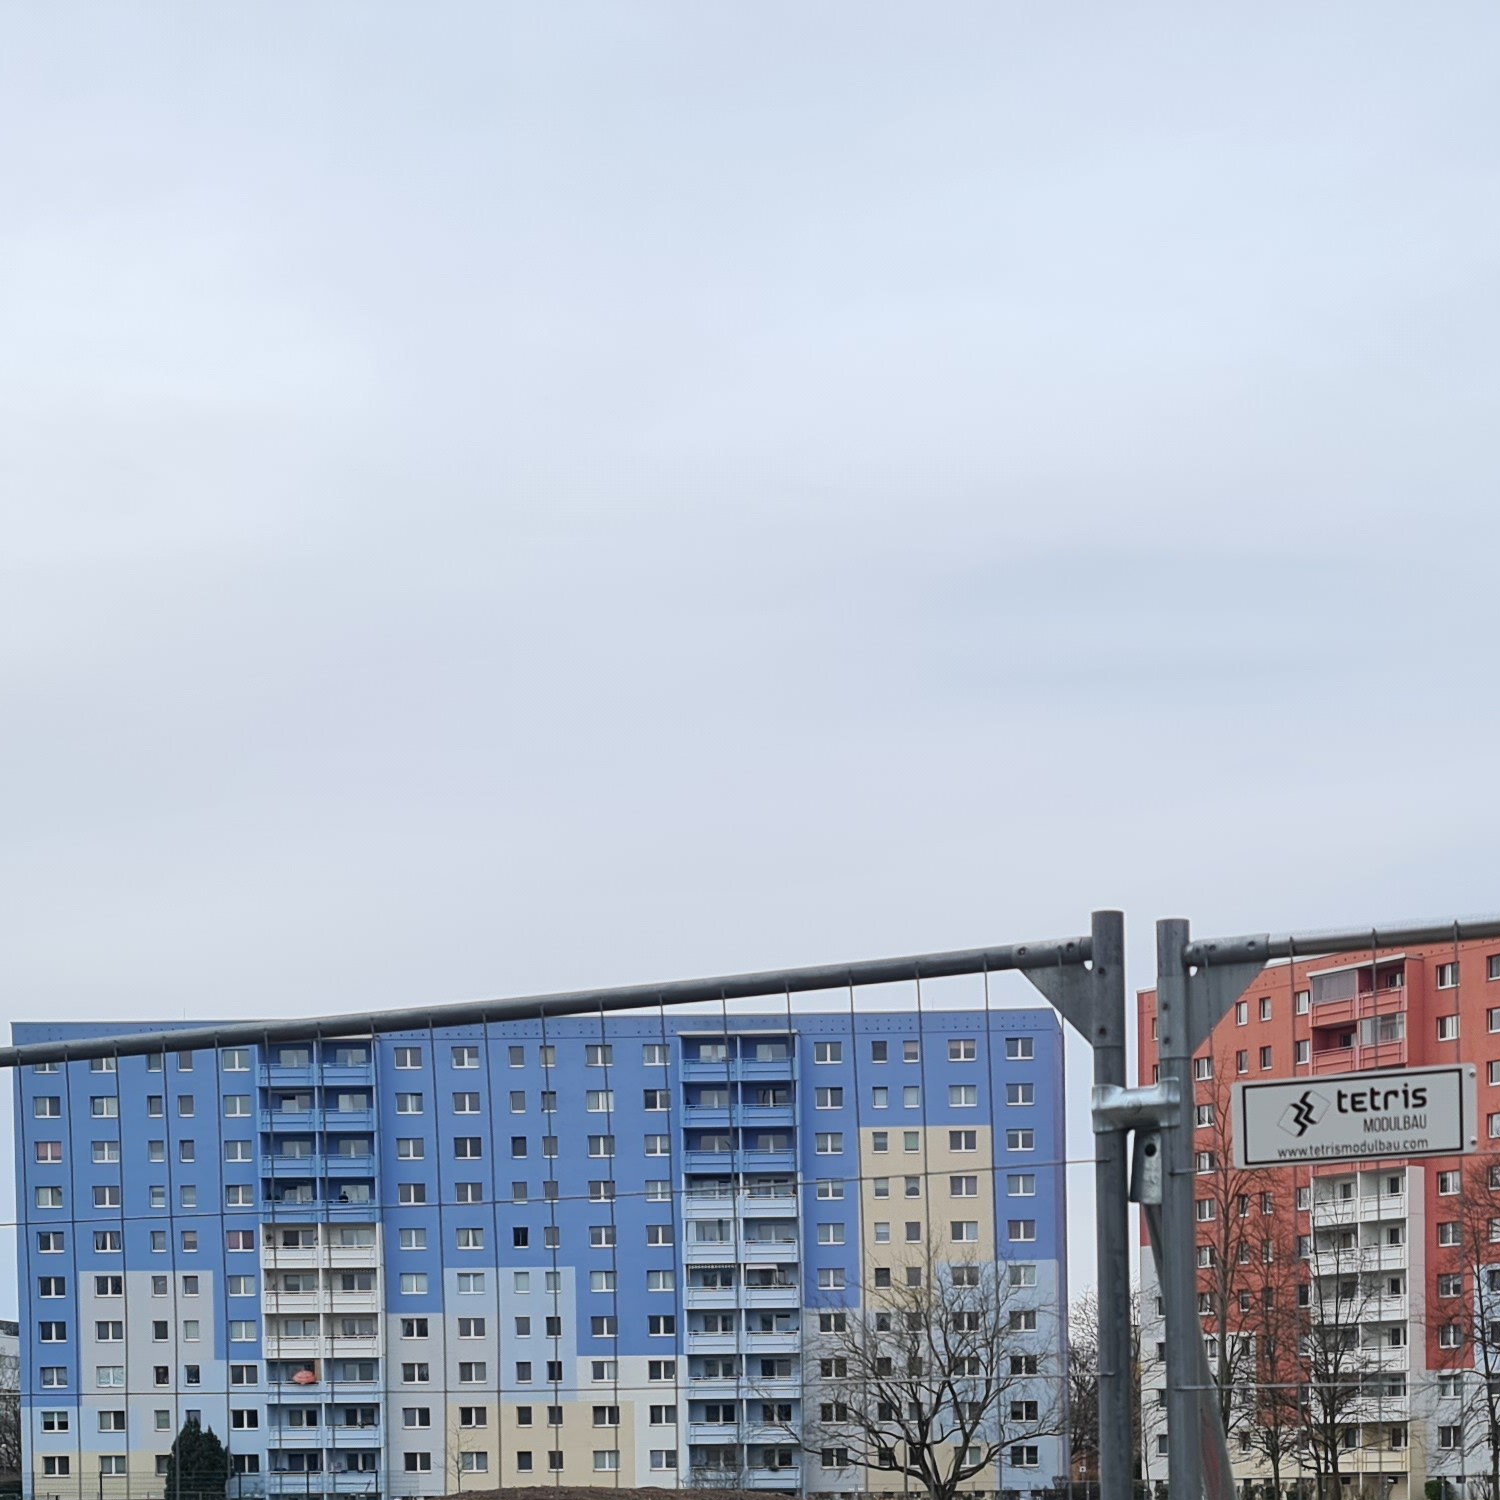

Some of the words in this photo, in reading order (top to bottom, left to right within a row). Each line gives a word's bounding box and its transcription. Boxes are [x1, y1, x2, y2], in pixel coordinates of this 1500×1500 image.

[1336, 1083, 1428, 1114] tetris
[1363, 1114, 1428, 1134] MODULBAU
[1277, 1138, 1429, 1159] www.tetrismodulbau.com
